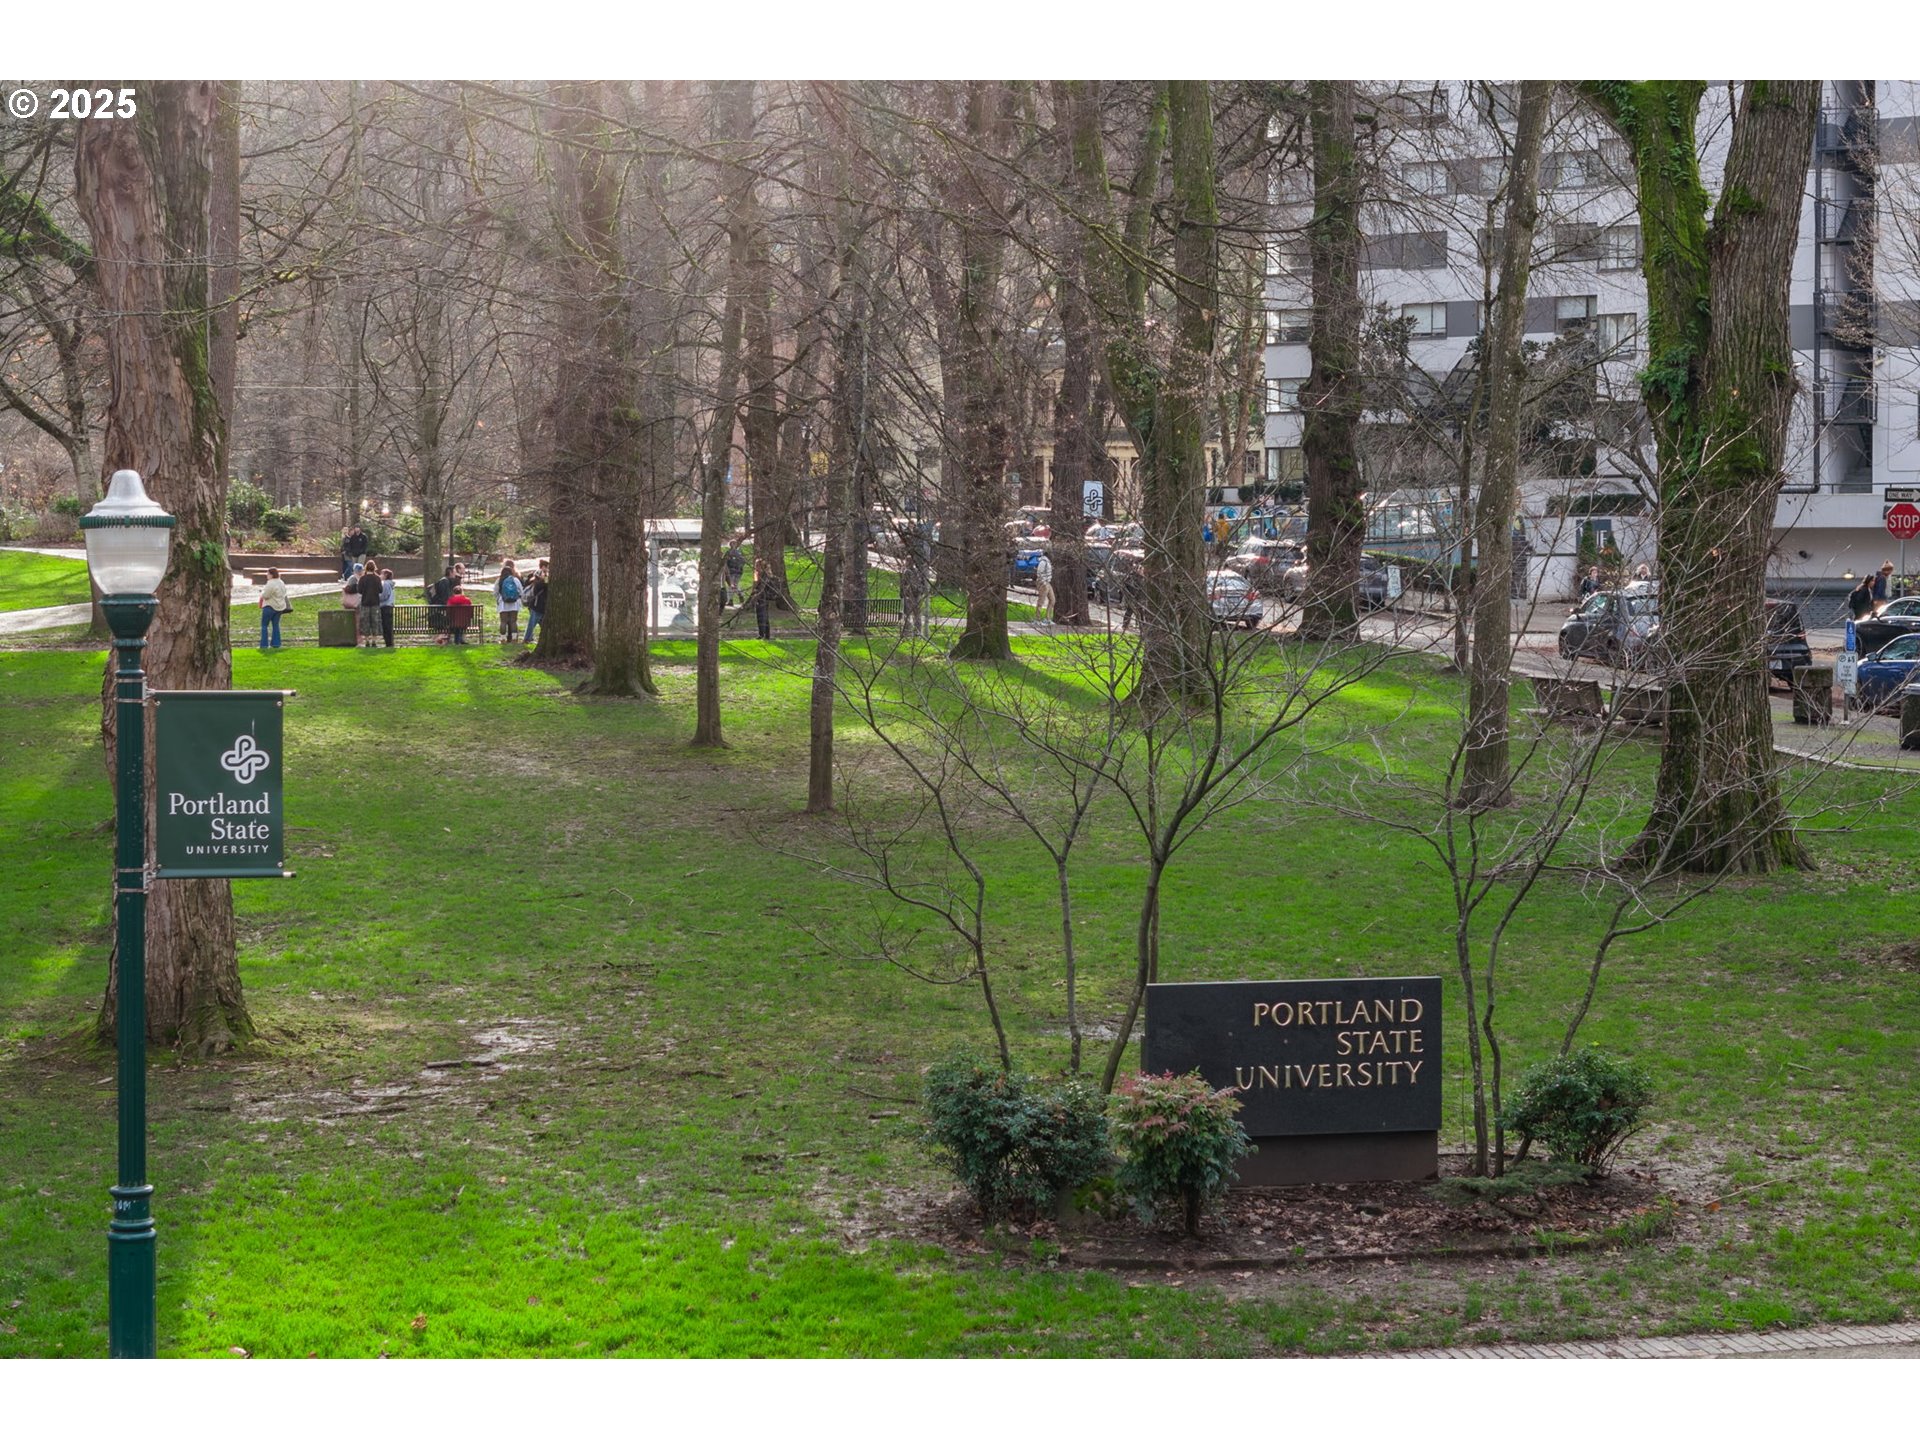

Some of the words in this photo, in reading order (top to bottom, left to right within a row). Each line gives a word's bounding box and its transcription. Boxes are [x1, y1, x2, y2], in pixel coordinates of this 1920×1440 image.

[1889, 514, 1919, 529] STOP
[168, 791, 271, 815] Portland
[210, 817, 270, 840] State
[186, 844, 270, 855] UNIVERSITY
[1253, 998, 1424, 1027] PORTLAND
[1336, 1029, 1425, 1056] STATE
[1235, 1060, 1424, 1091] UNIVERSITY
